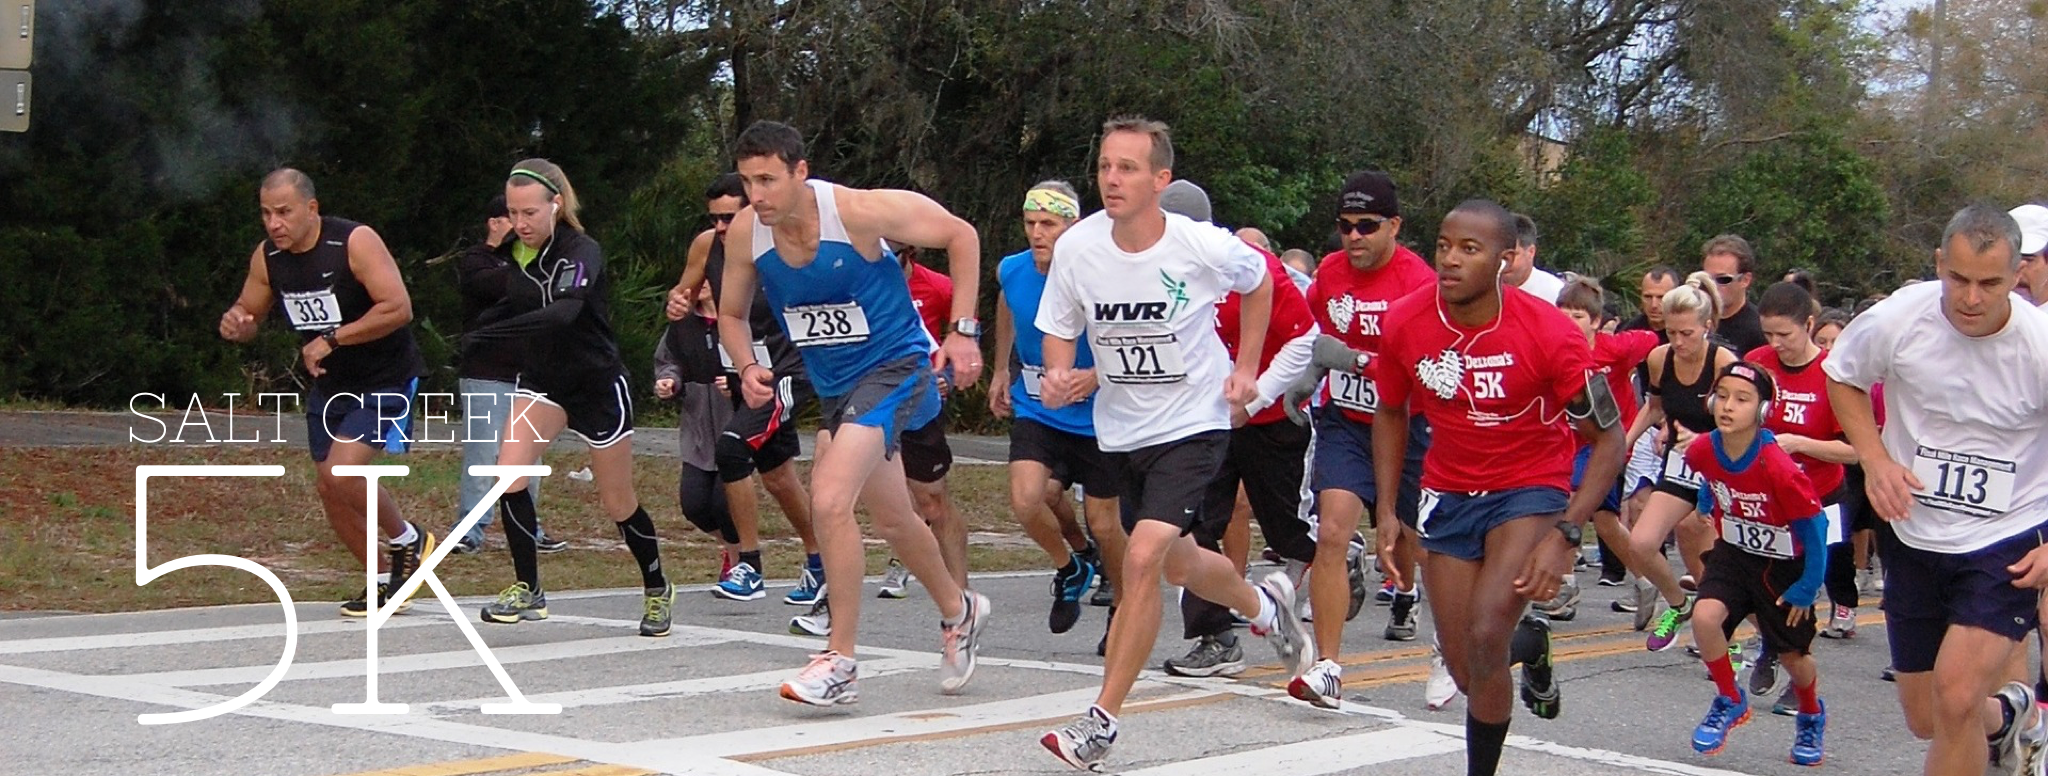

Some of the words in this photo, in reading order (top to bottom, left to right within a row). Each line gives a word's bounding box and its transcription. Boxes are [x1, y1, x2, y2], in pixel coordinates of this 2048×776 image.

[294, 298, 329, 322] 313
[801, 309, 852, 337] 238
[1094, 302, 1167, 321] WVR
[1359, 314, 1381, 335] 5K
[1116, 346, 1165, 375] 121
[1340, 373, 1375, 405] 275
[1473, 372, 1505, 399] 5K
[1782, 402, 1806, 425] 5K
[1933, 462, 1988, 504] 113
[1739, 501, 1766, 518] 5K
[1735, 524, 1777, 552] 182
